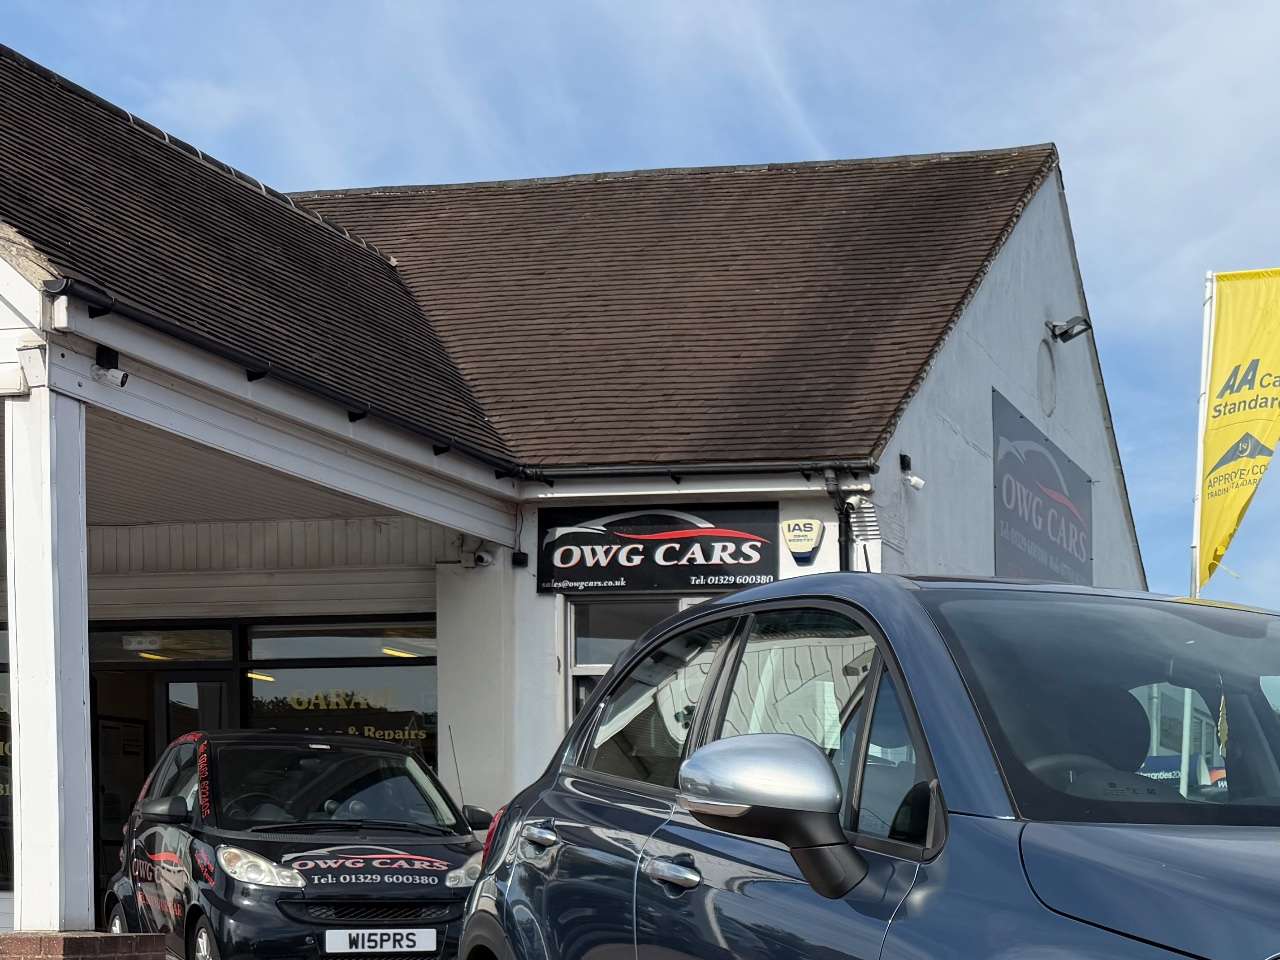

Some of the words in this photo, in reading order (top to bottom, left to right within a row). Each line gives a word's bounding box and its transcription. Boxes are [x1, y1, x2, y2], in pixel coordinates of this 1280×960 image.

[1215, 358, 1261, 399] AA
[1002, 472, 1043, 531] OWG
[1047, 508, 1087, 563] CARS
[787, 522, 814, 533] IAS
[553, 544, 645, 568] OWG
[654, 541, 762, 566] CARS
[541, 577, 627, 590] sales@owgcars.co.uk
[690, 575, 706, 585] Tel:
[707, 575, 735, 585] 01329
[736, 574, 774, 585] 600380
[363, 725, 427, 741] Repairs
[291, 859, 366, 871] OWG
[372, 859, 449, 871] CARS
[311, 874, 337, 884] Tel:
[339, 874, 381, 884] 01329
[384, 874, 439, 885] 600380
